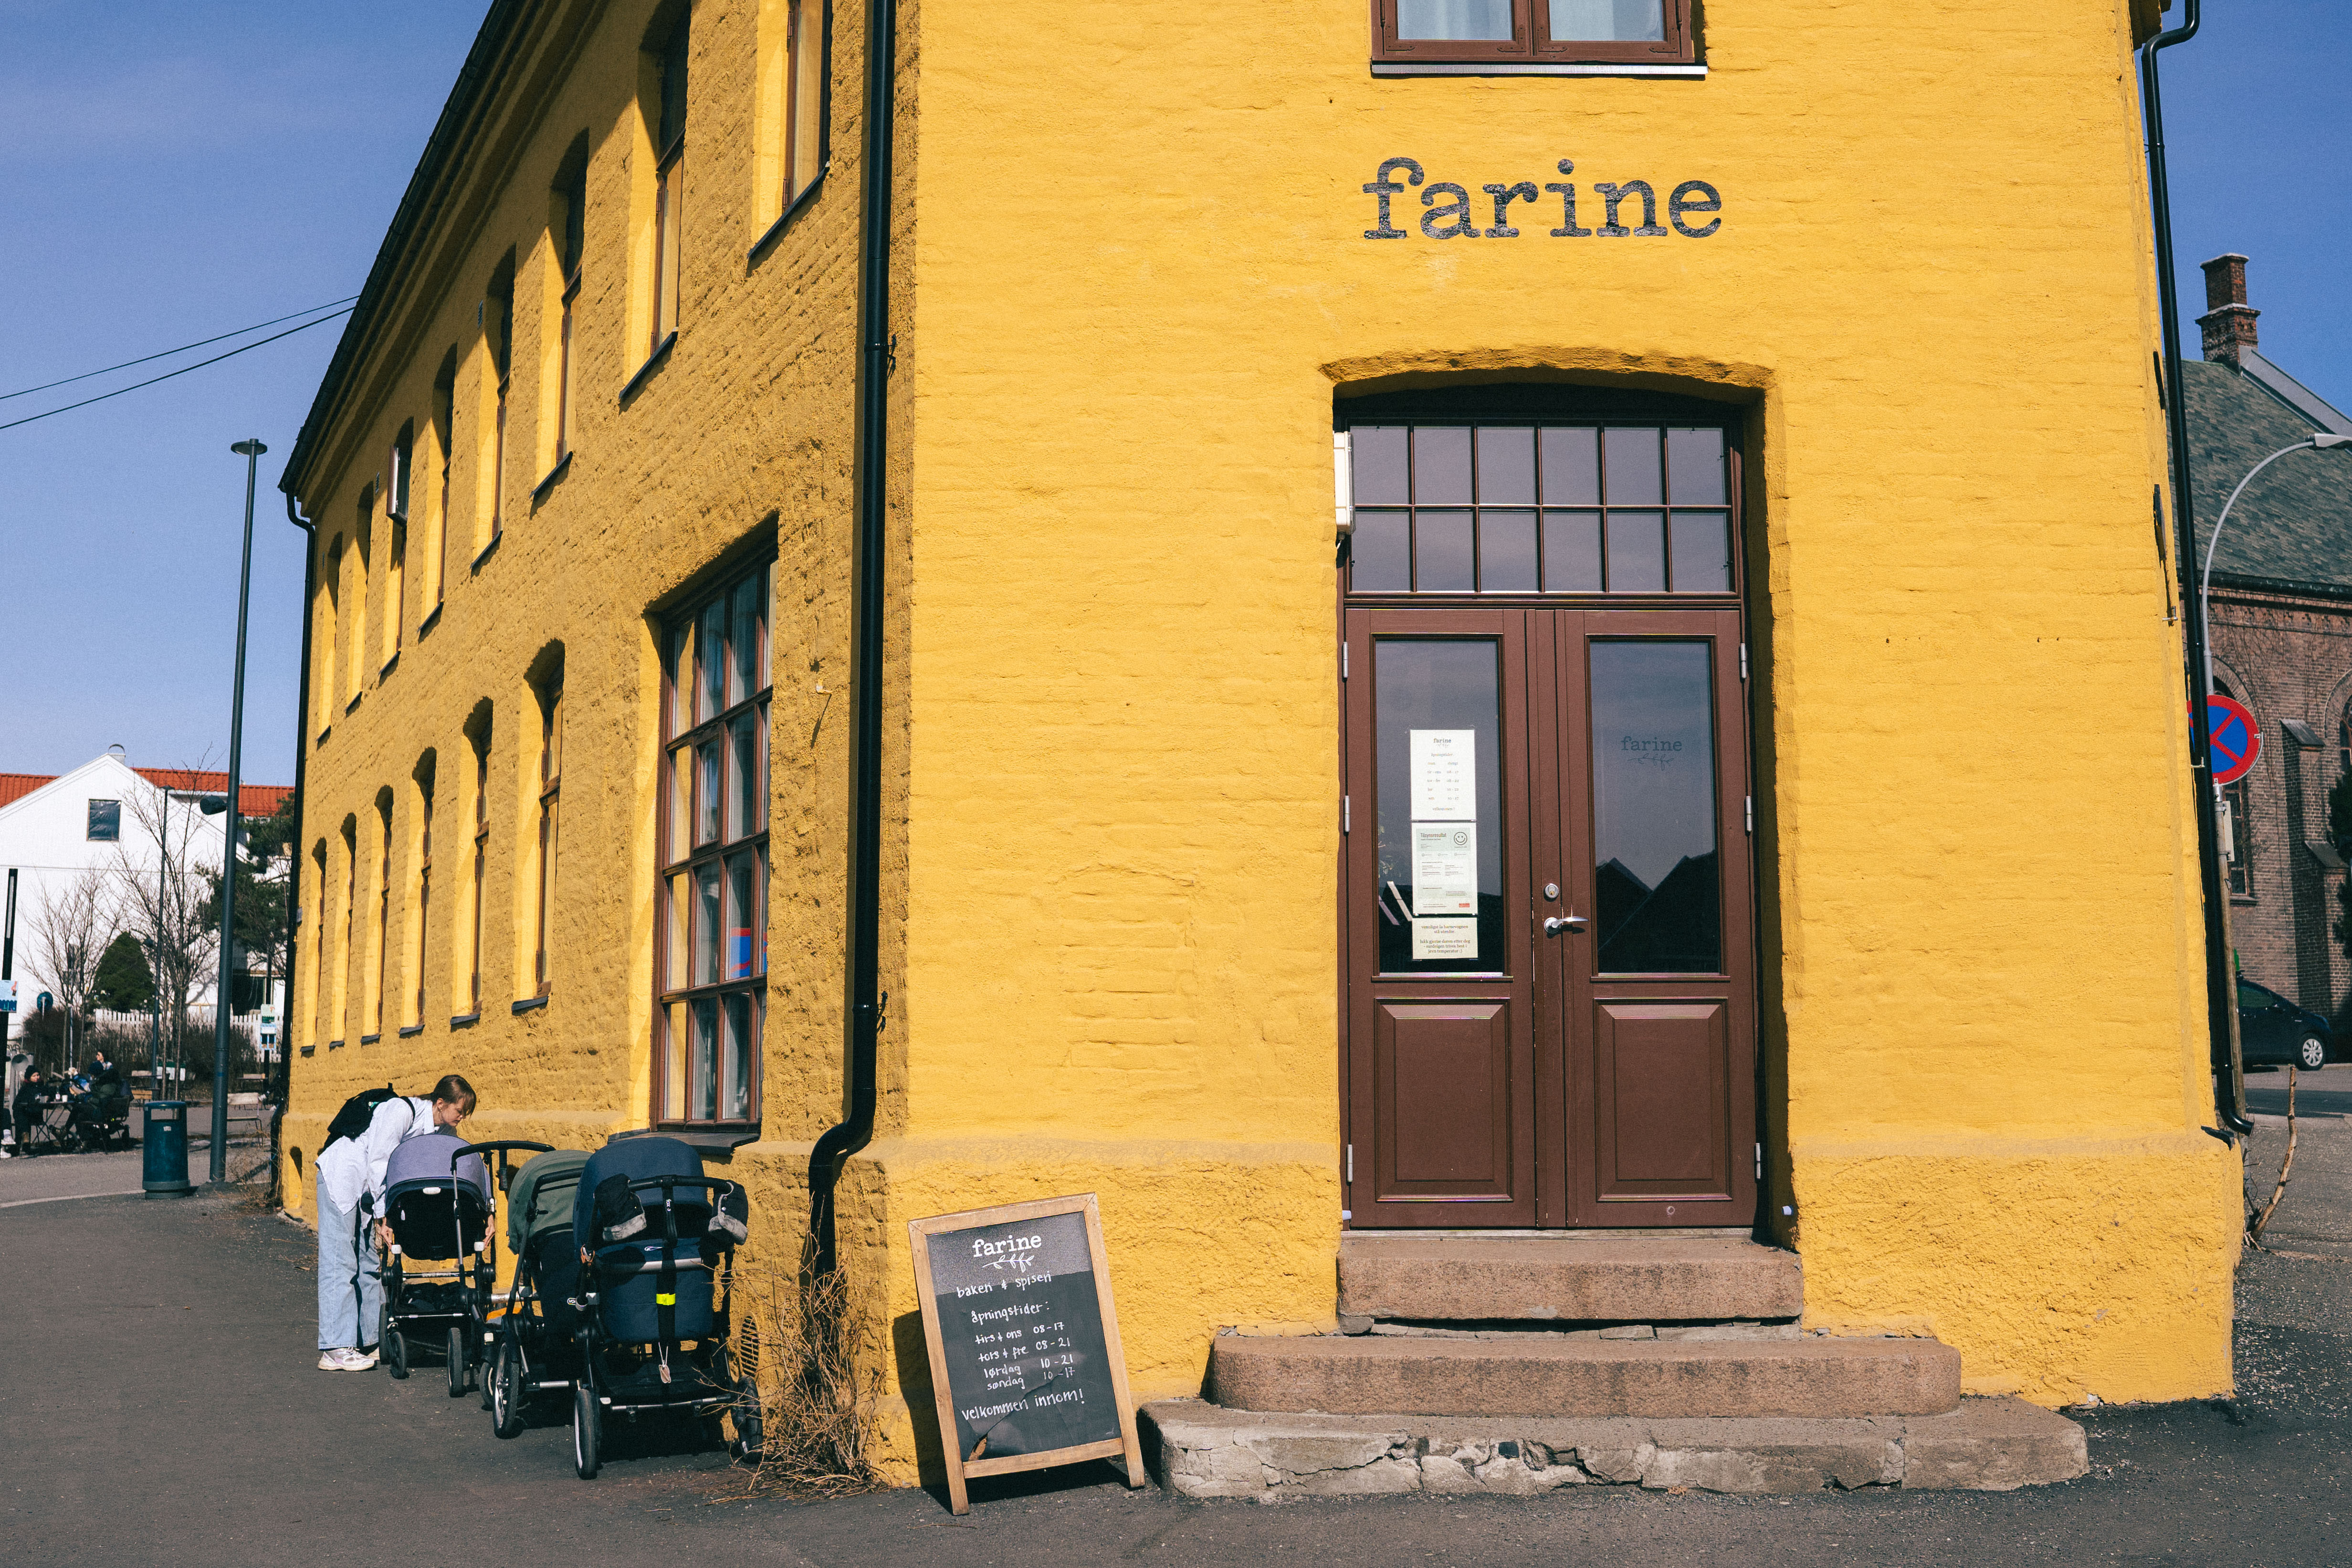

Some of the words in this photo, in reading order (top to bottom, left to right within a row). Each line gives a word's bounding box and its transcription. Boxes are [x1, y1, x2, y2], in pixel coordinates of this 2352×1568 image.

[1362, 156, 1722, 240] farine
[1621, 736, 1682, 752] farine
[972, 1234, 1042, 1257] farine
[956, 1282, 993, 1298] baken
[1015, 1271, 1052, 1291] spisen
[975, 1334, 996, 1345] tirs
[1006, 1329, 1022, 1339] ons
[978, 1350, 999, 1362] tors
[1012, 1346, 1029, 1359] fre
[984, 1364, 1022, 1379] lørdag
[987, 1376, 1026, 1390] søndag
[961, 1399, 1029, 1421] velkommen
[1034, 1388, 1085, 1408] innom!
